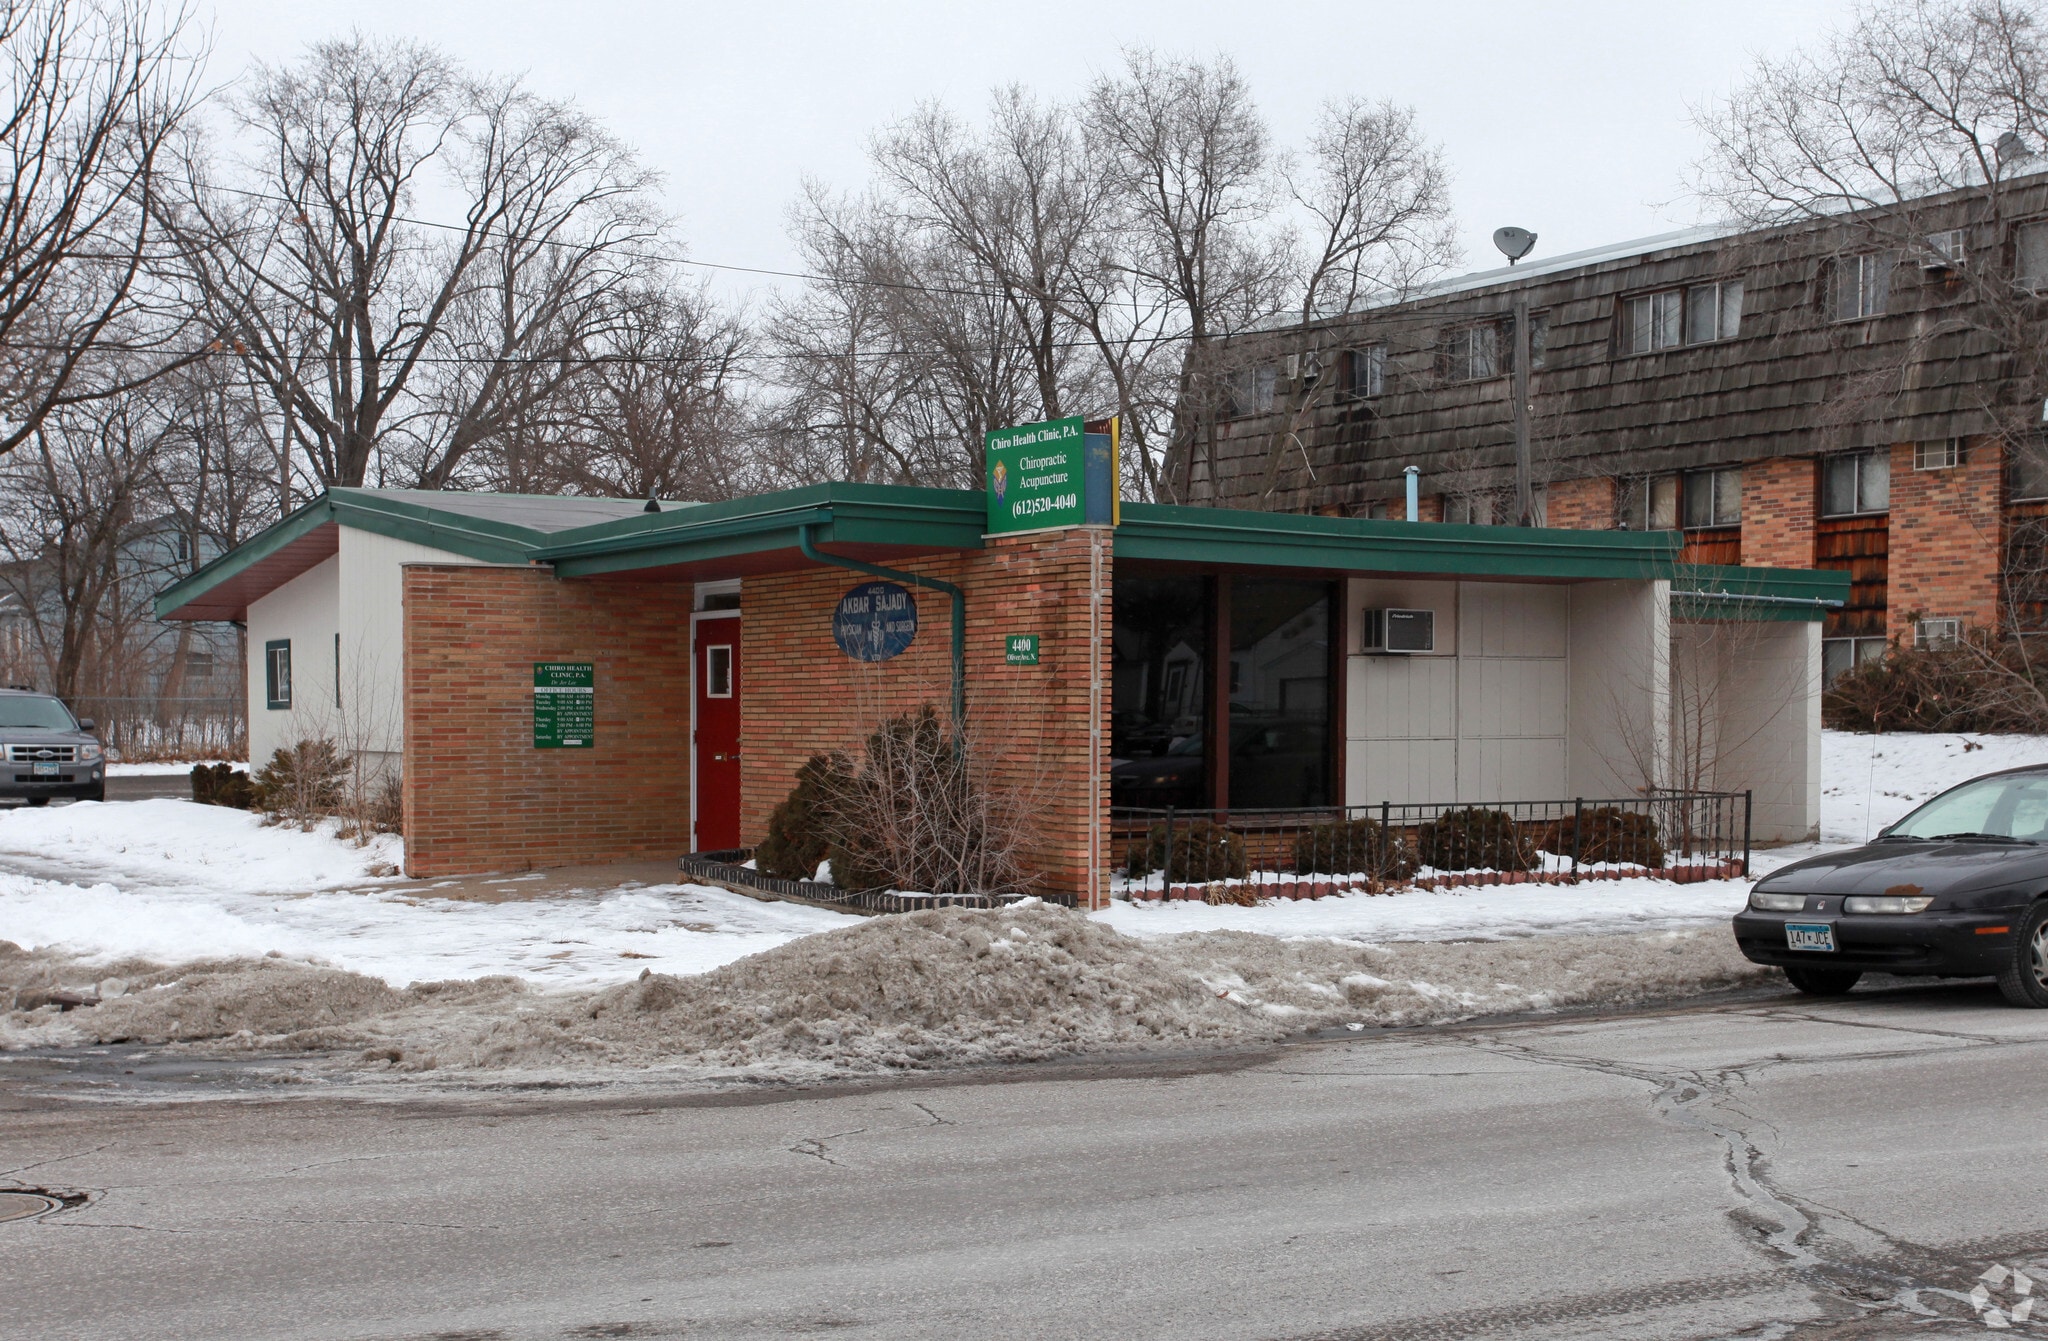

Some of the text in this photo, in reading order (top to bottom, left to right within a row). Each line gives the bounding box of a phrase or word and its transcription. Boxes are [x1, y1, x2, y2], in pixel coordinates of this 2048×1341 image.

[991, 425, 1079, 451] Chiro Health Clinic, P.A.
[1019, 451, 1067, 471] Chiropractic
[1019, 472, 1068, 490] Acupuncture
[1012, 493, 1077, 519] (612)520-4040
[867, 586, 885, 595] 4400
[842, 593, 906, 614] AKBAR SAJADY
[1012, 638, 1031, 651] 4400
[1790, 931, 1831, 945] 147 JCE
